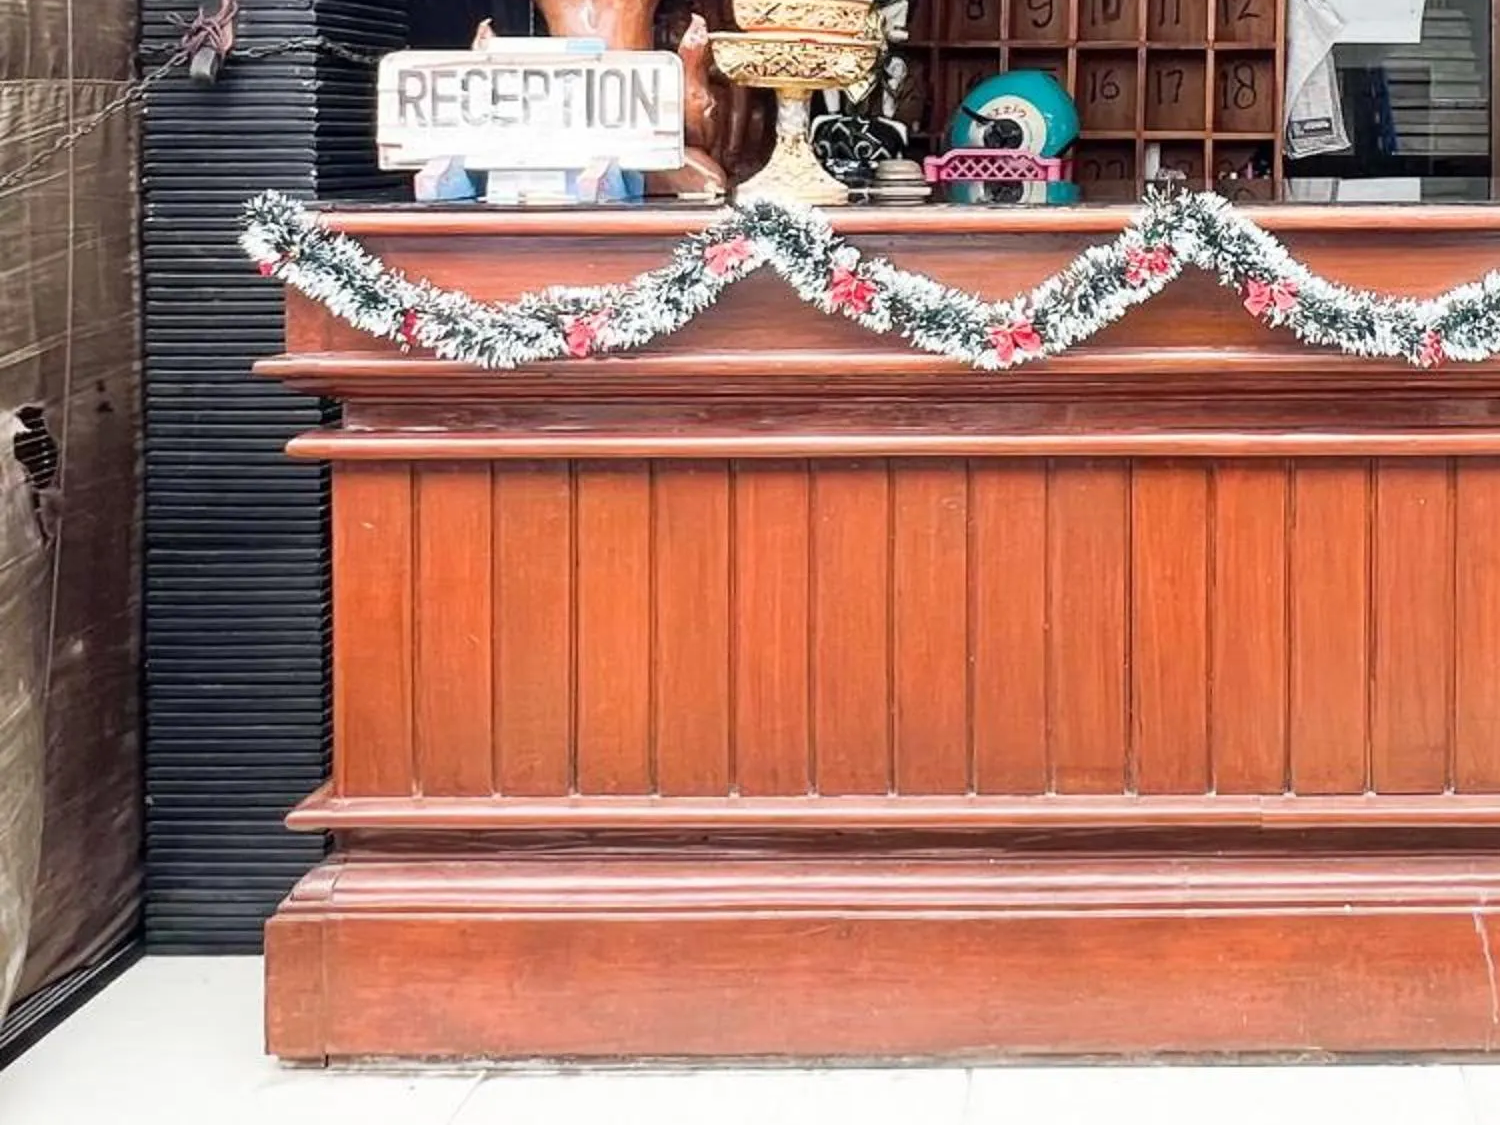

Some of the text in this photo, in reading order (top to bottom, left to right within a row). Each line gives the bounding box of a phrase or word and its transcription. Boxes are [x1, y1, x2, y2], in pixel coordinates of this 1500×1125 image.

[397, 67, 662, 129] RECEPTION
[1089, 70, 1121, 104] 16
[1156, 68, 1185, 105] 17
[1221, 63, 1257, 111] 18
